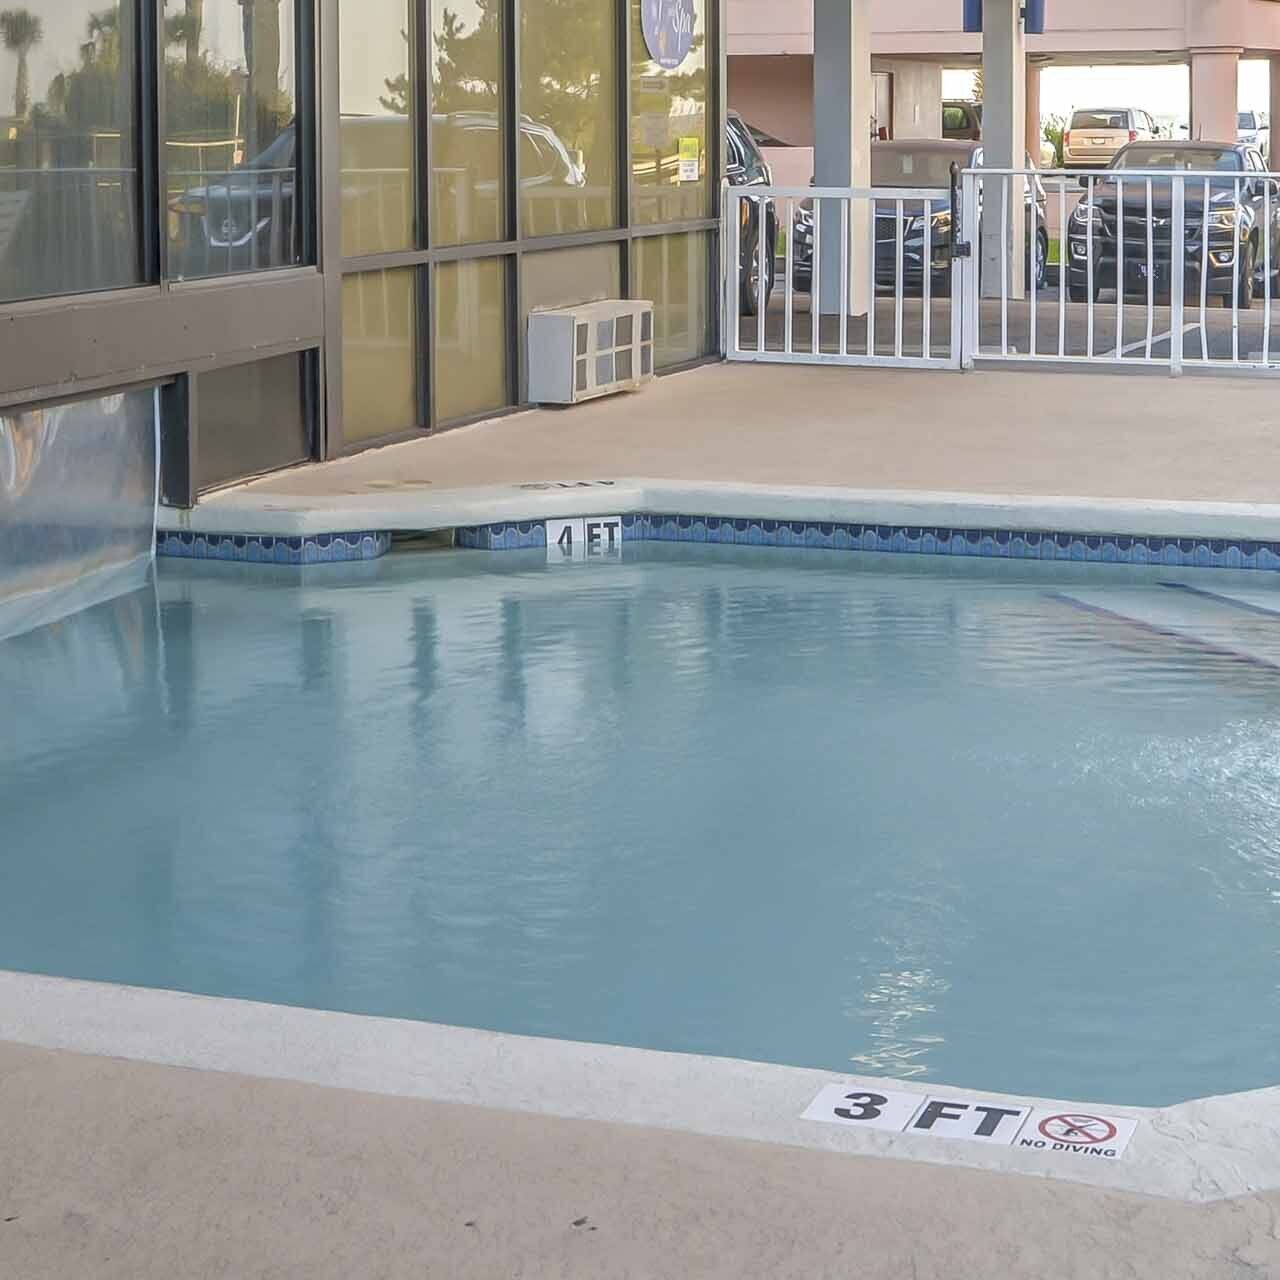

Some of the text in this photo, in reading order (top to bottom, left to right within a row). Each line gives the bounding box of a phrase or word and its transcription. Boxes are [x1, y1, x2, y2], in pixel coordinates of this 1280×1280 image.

[672, 0, 692, 53] Spa
[586, 522, 620, 543] FT
[833, 1091, 1020, 1137] 3 FT
[1019, 1138, 1117, 1157] NO DIVING
